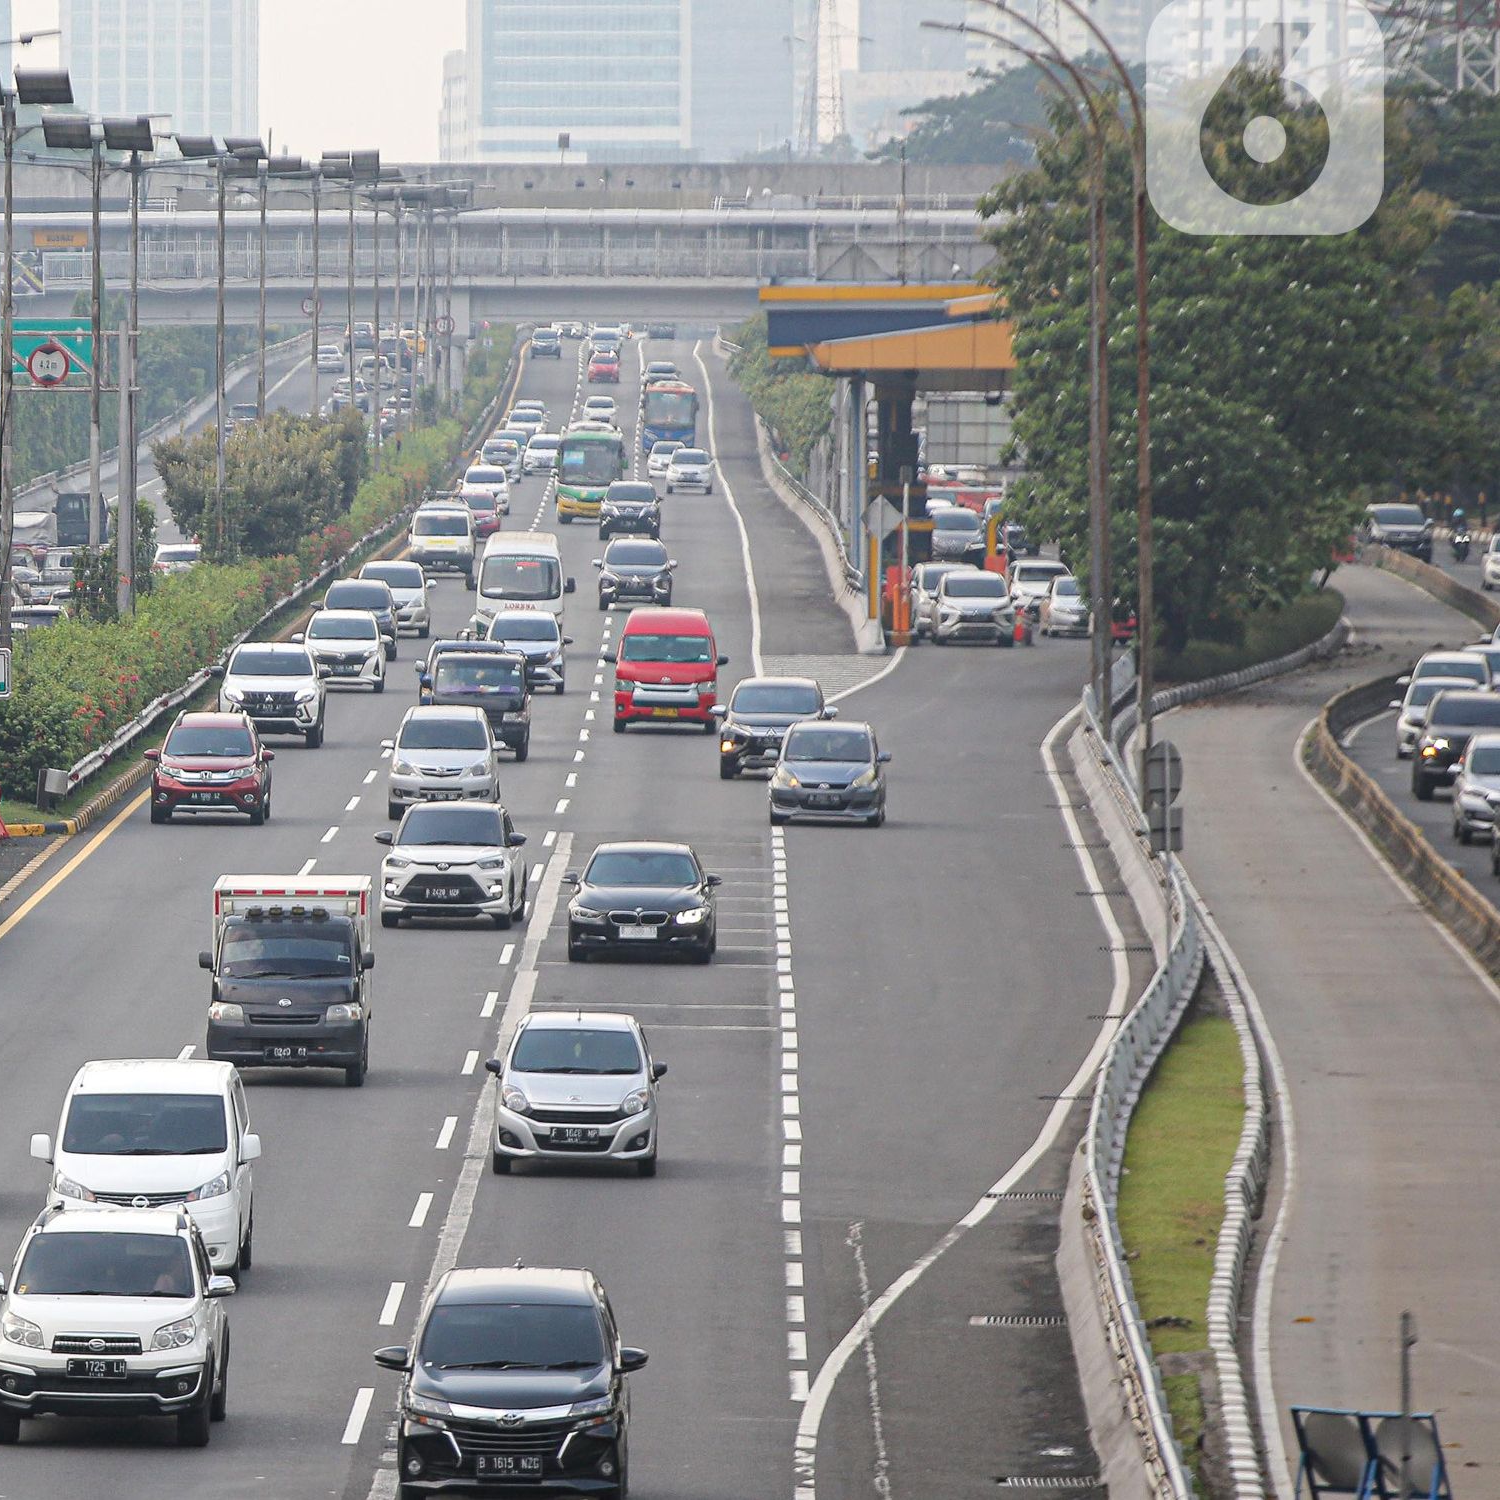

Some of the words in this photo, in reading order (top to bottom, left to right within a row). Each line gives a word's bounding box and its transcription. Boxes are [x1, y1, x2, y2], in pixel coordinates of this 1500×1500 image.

[67, 1360, 75, 1371] F
[85, 1360, 106, 1372] 1725
[113, 1361, 125, 1373] LH
[479, 1456, 486, 1469] B
[493, 1456, 514, 1469] 1615
